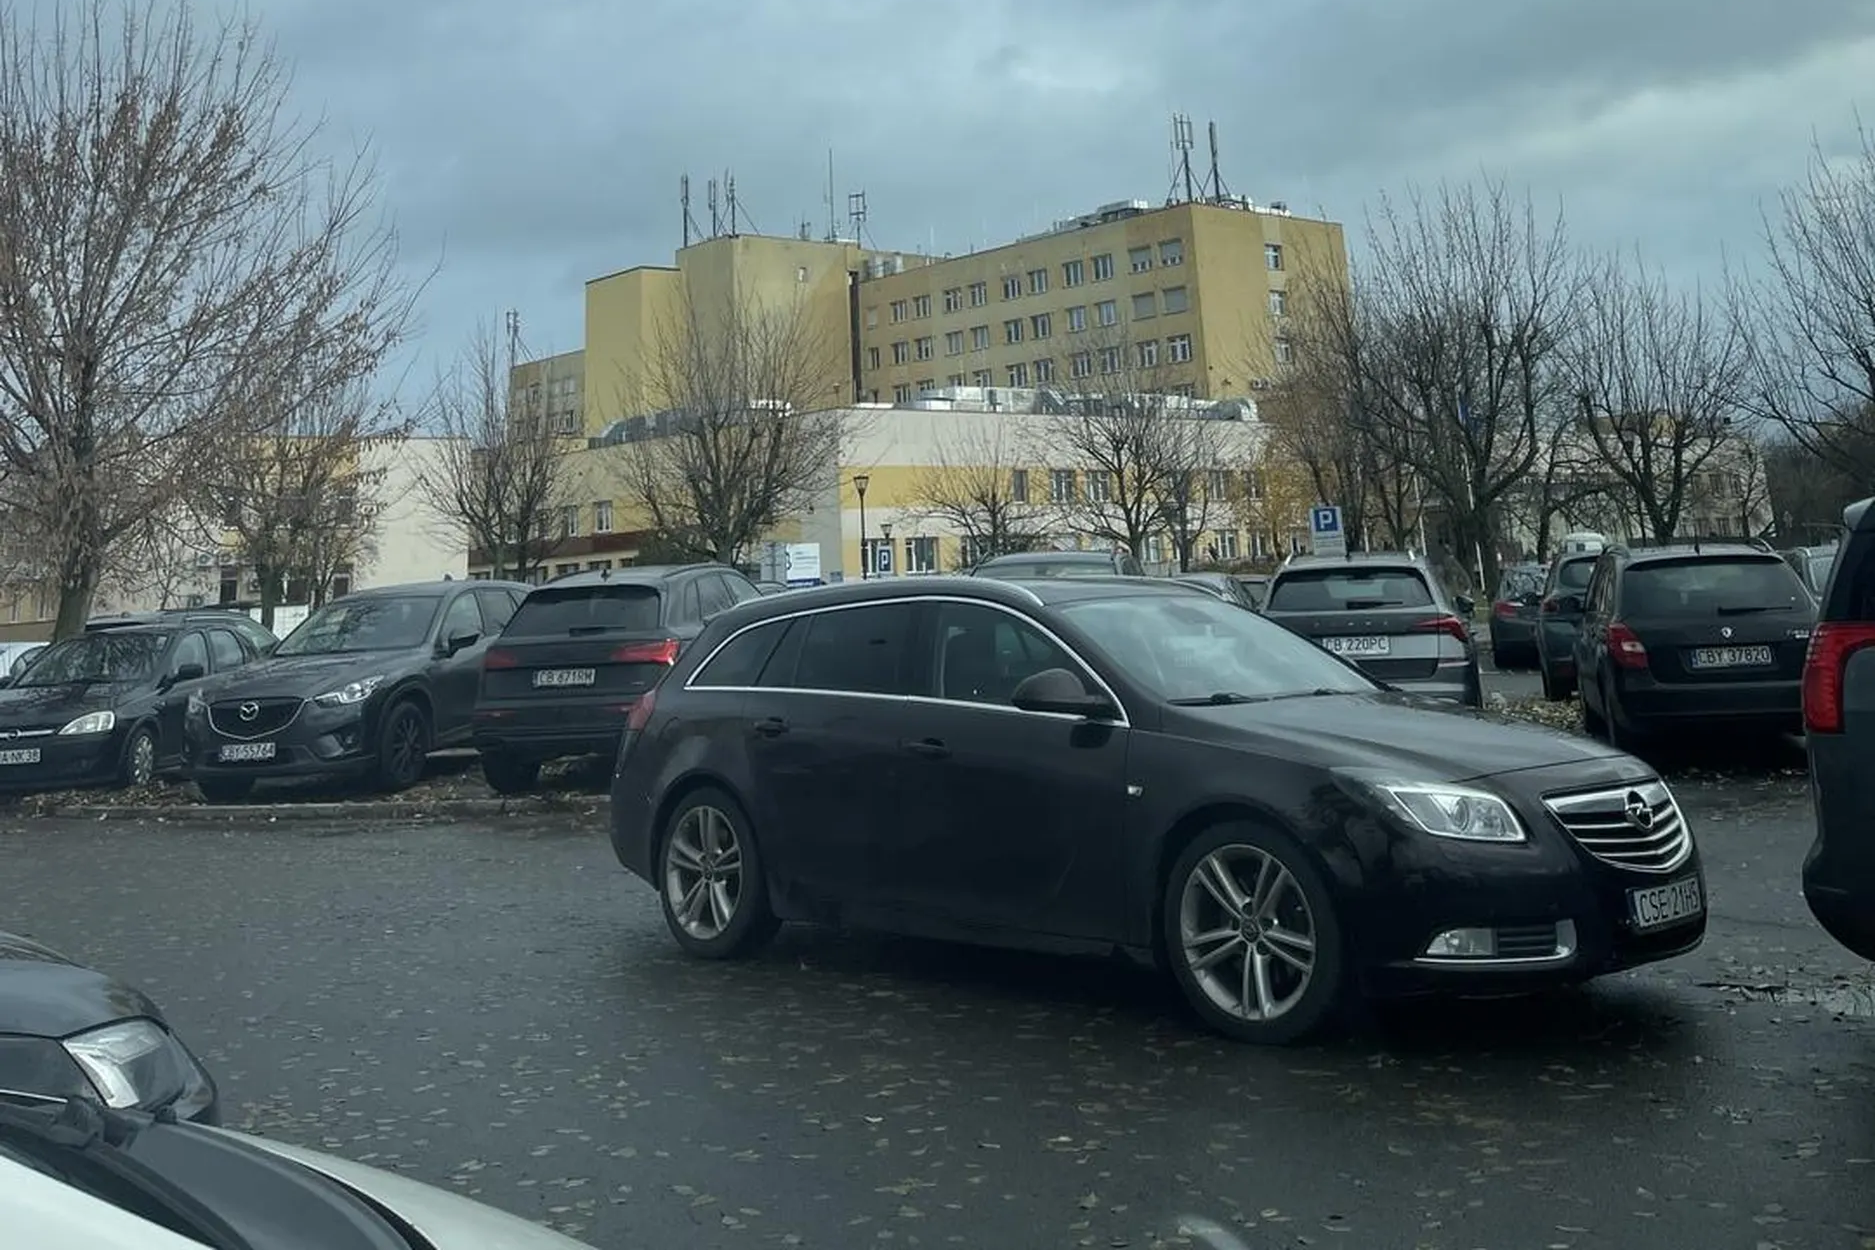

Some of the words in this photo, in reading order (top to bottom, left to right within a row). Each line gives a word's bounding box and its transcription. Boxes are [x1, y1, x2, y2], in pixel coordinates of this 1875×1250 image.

[1319, 510, 1333, 529] P
[881, 551, 890, 569] P
[1346, 637, 1386, 651] 220PC
[1699, 650, 1723, 664] CBY
[1728, 647, 1769, 663] 37820
[1640, 889, 1669, 923] CSE
